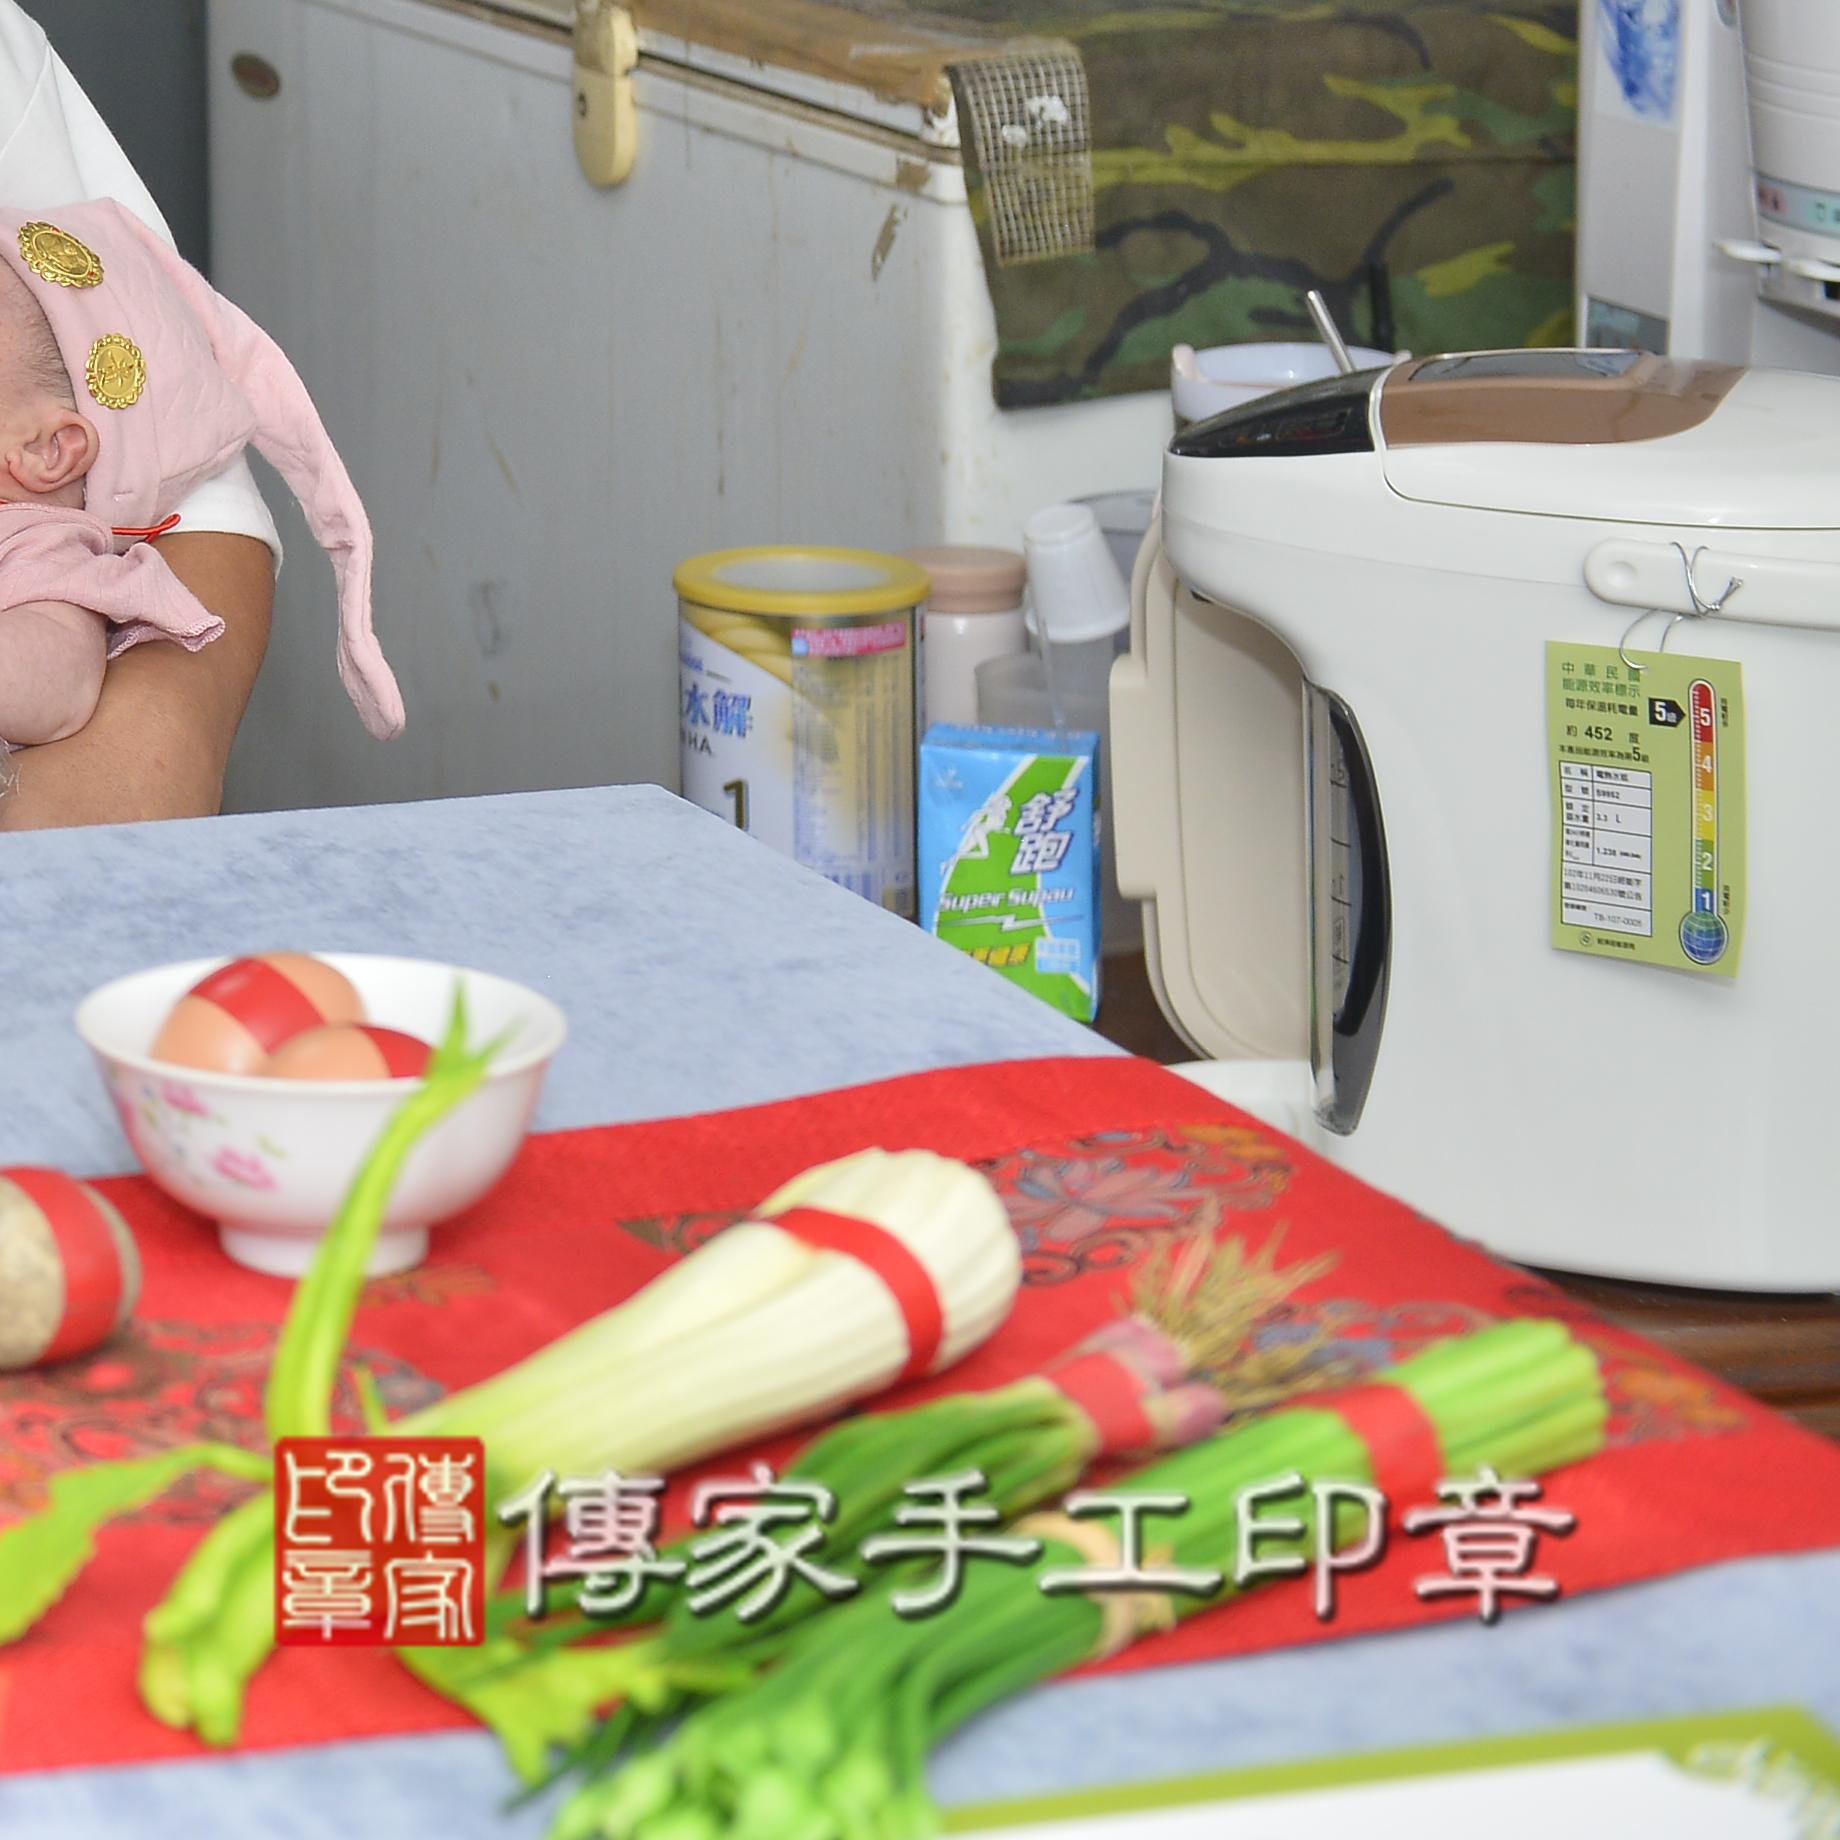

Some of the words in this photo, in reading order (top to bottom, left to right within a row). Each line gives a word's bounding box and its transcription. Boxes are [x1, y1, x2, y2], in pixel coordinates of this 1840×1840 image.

[1562, 662, 1640, 682] 中華民國
[1562, 678, 1640, 698] 能源效率標示
[1565, 698, 1638, 717] 每年保溫耗電量
[1699, 708, 1711, 727] 5
[1584, 726, 1612, 741] 452
[1702, 756, 1713, 773] 4
[723, 778, 750, 831] 1
[1703, 804, 1713, 821] 3
[1011, 787, 1078, 876] 舒跑
[1703, 853, 1713, 871] 2
[939, 891, 1005, 913] Super
[1702, 892, 1711, 910] 1
